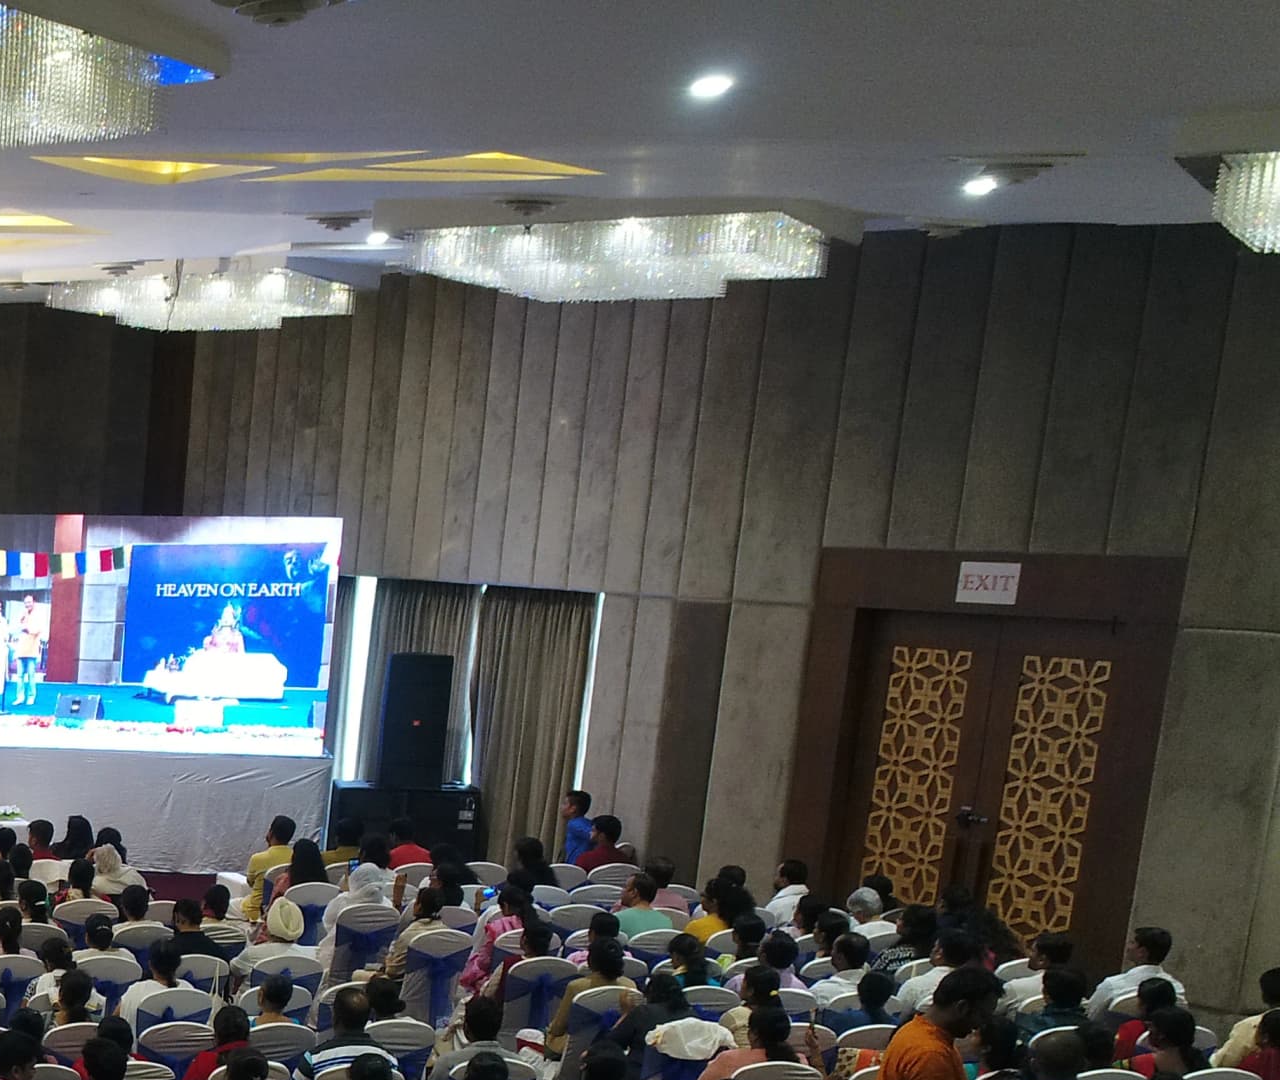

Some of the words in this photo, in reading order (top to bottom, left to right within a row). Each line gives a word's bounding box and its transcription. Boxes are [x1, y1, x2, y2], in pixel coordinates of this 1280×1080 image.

[155, 583, 218, 597] HEAVEN
[220, 583, 246, 597] ON
[248, 583, 301, 597] EARTH
[962, 574, 1015, 591] EXIT
